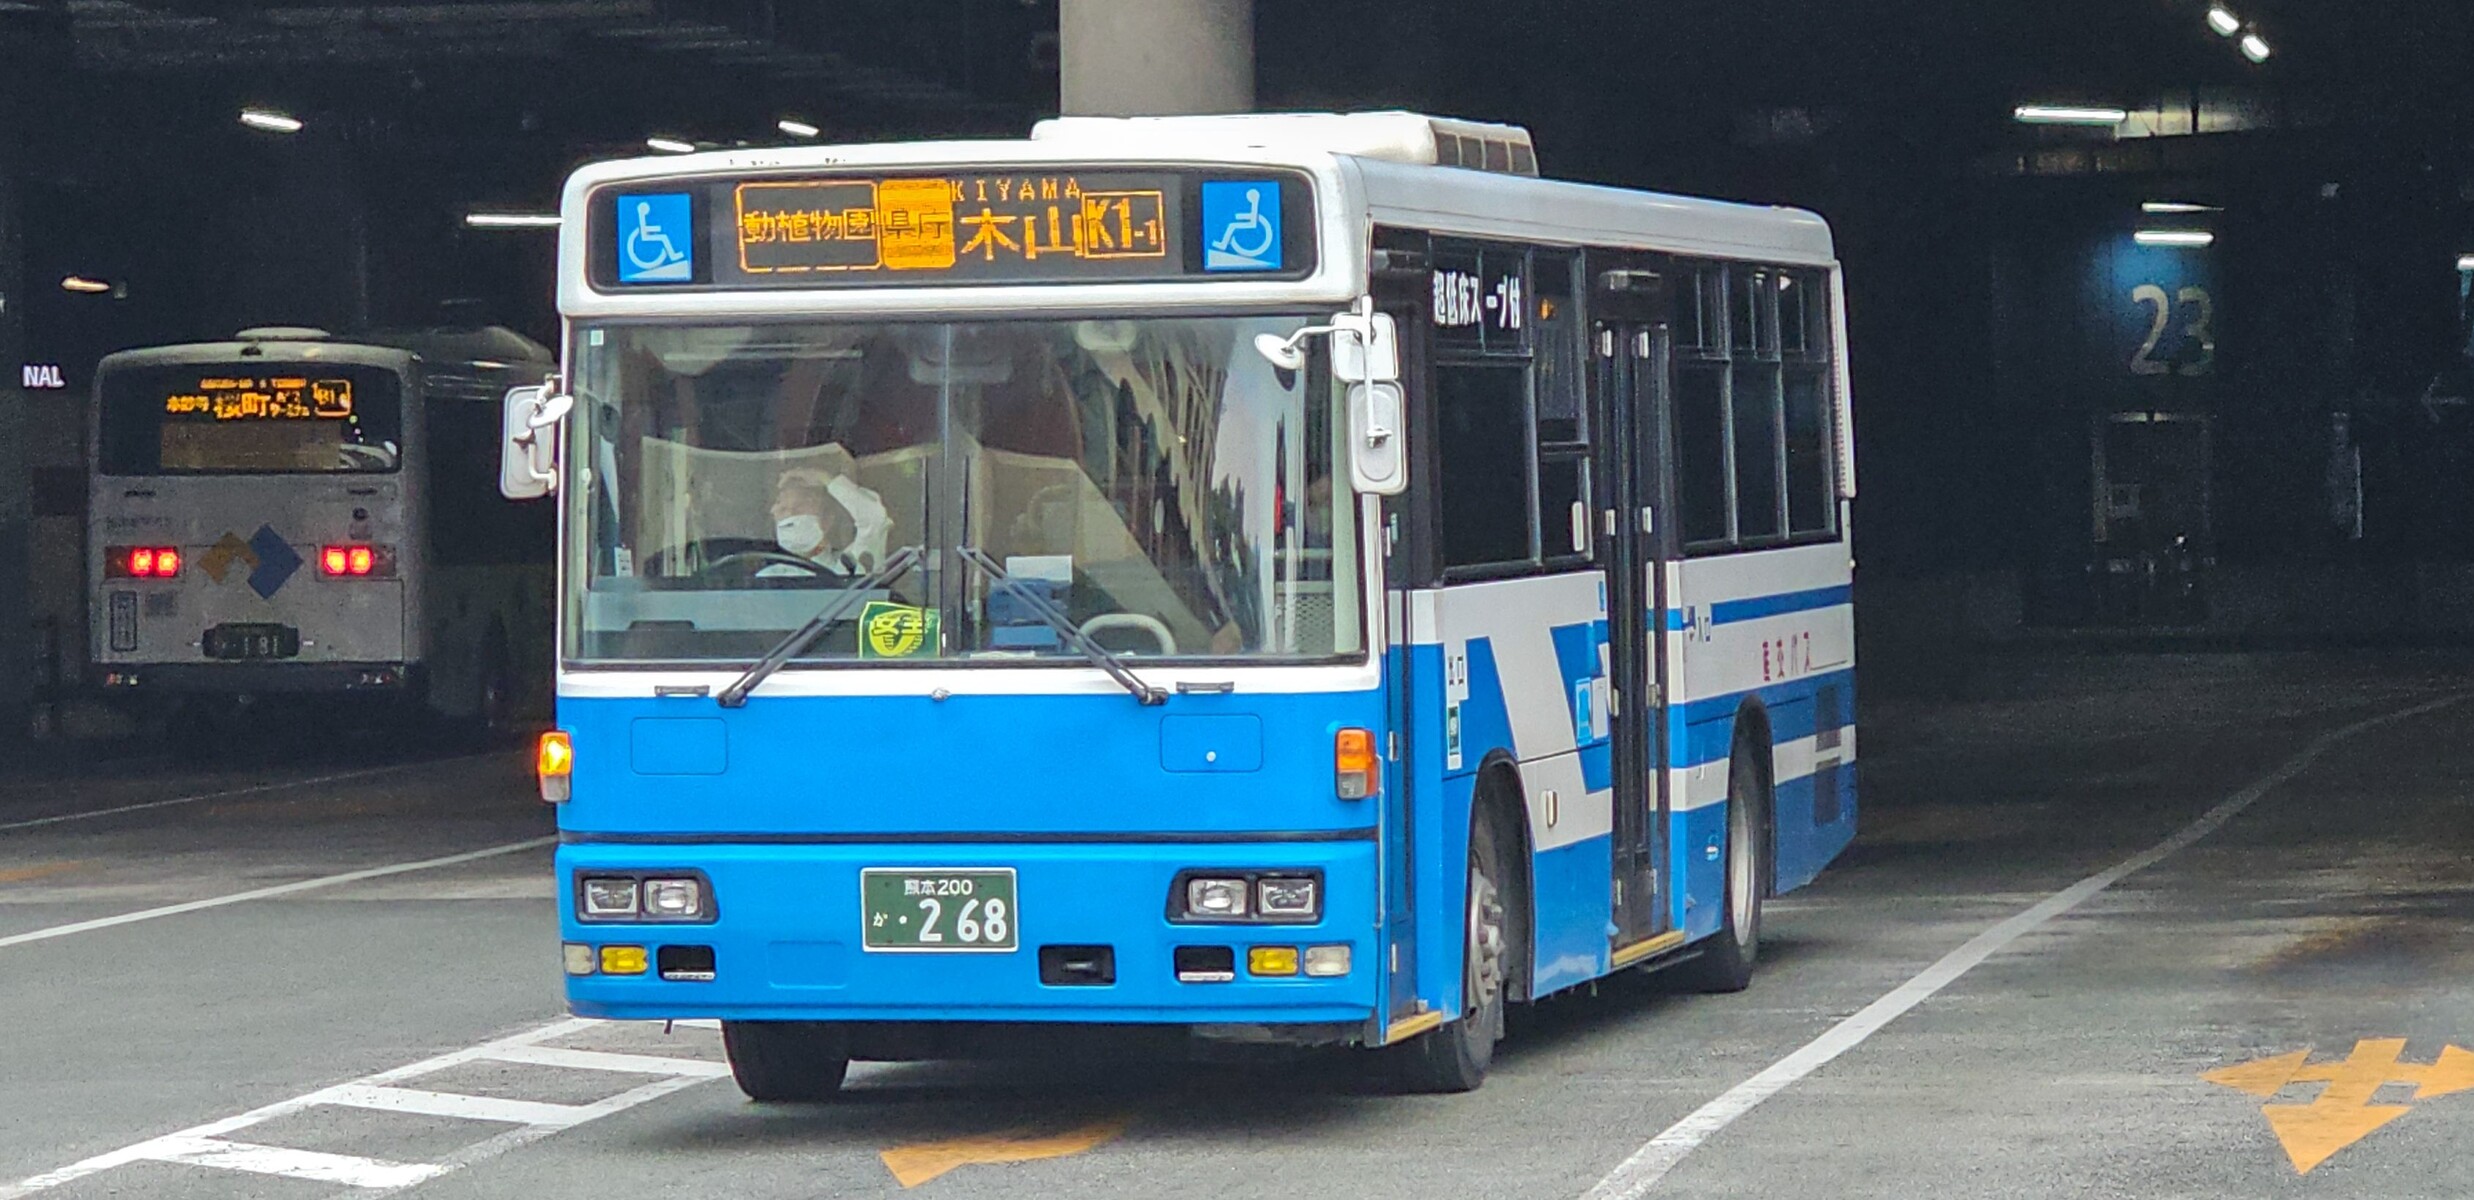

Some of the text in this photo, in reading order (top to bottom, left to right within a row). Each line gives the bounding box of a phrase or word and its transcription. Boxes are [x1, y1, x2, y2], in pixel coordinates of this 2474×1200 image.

[950, 177, 1081, 202] KIYAMA
[743, 208, 876, 243] 動植物園
[883, 210, 951, 240] 県庁
[959, 206, 1083, 260] 木山
[2130, 284, 2214, 376] 23
[23, 365, 65, 387] NAL
